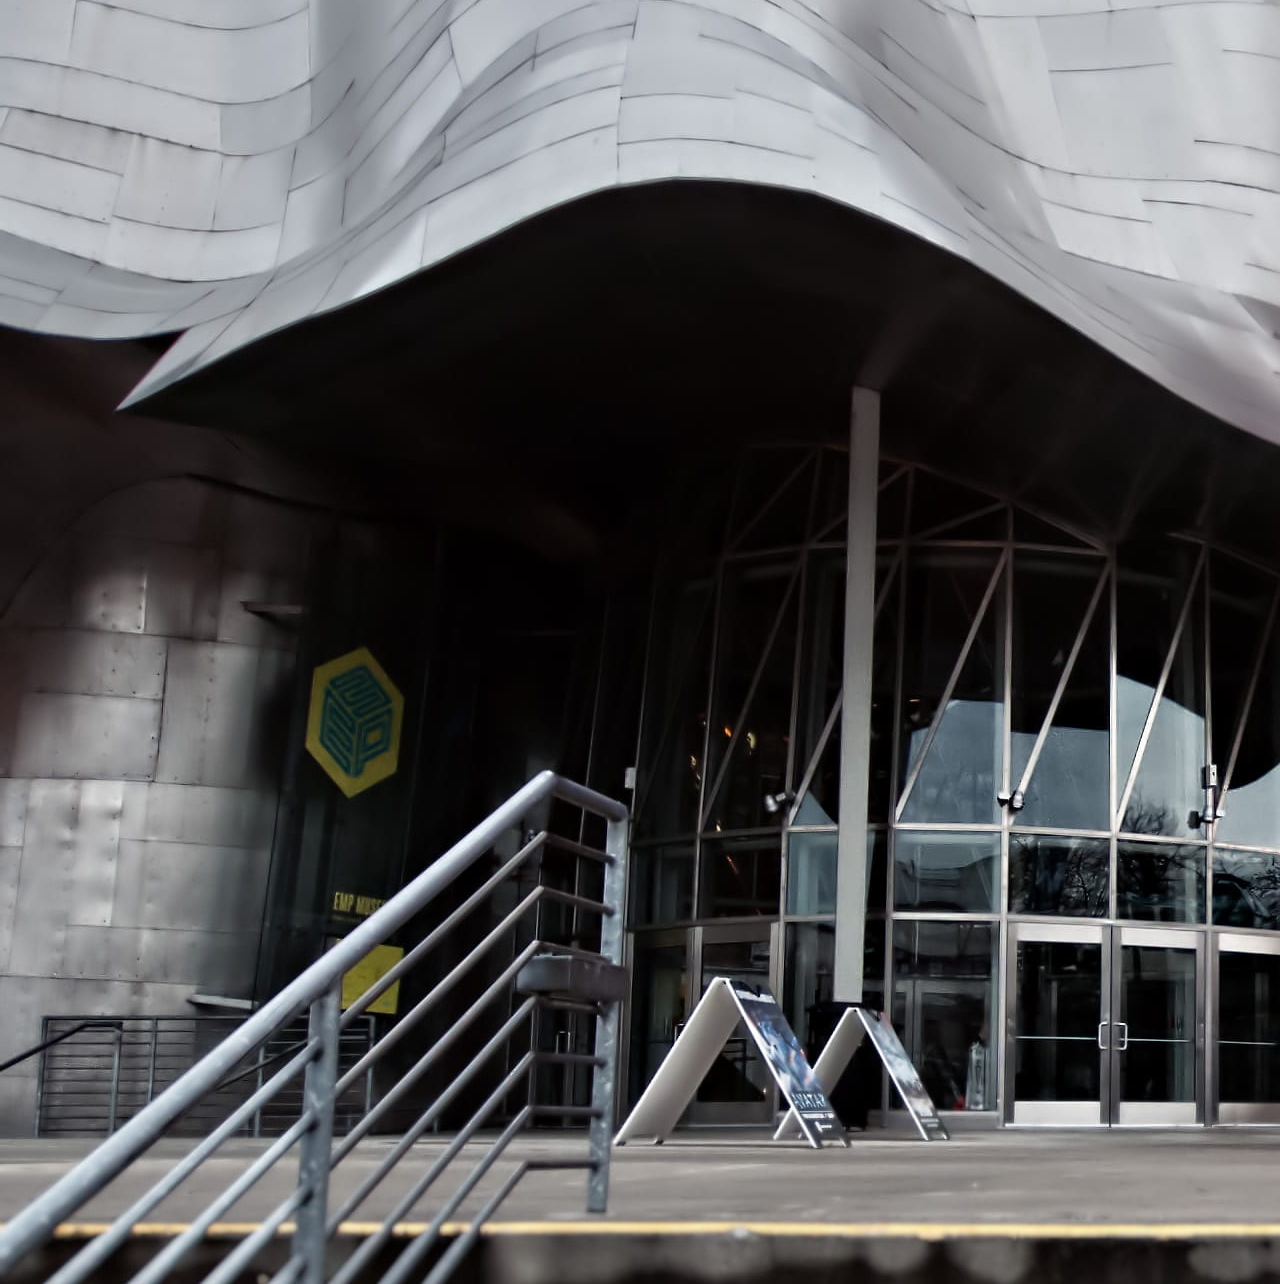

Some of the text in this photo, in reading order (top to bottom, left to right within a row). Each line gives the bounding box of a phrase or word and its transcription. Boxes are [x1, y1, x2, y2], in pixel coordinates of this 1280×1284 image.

[333, 891, 386, 916] EMP MUSE
[791, 1092, 826, 1109] AVATAR
